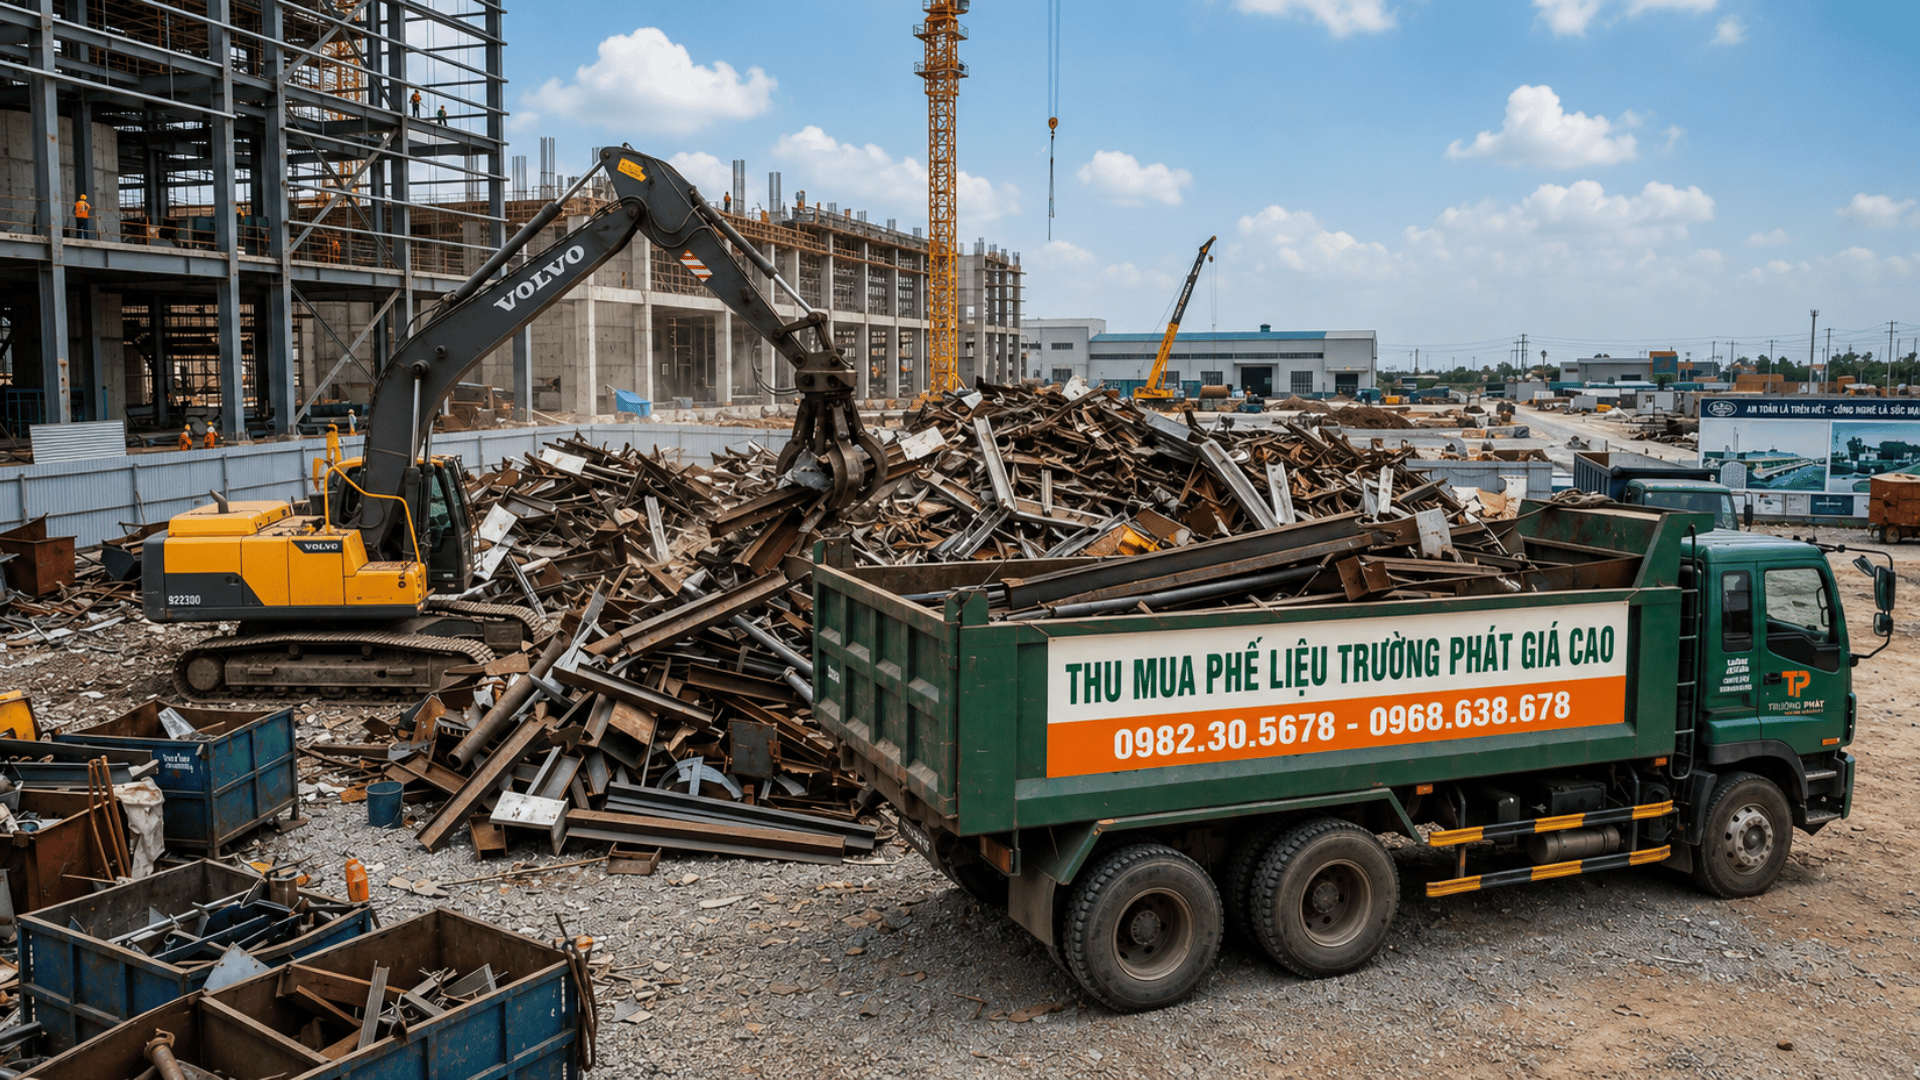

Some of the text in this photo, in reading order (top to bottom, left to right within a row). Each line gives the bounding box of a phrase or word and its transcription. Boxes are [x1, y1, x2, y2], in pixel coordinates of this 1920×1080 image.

[493, 245, 585, 312] VOLVO
[304, 543, 339, 551] VOLVO
[1065, 621, 1615, 705] THU MUA PHẾ LIỆU TRƯỜNG PHÁT GIÁ CAO
[1781, 670, 1811, 698] TP
[1114, 711, 1336, 760] 0982.30.5678
[1369, 691, 1571, 736] 0968.638.678
